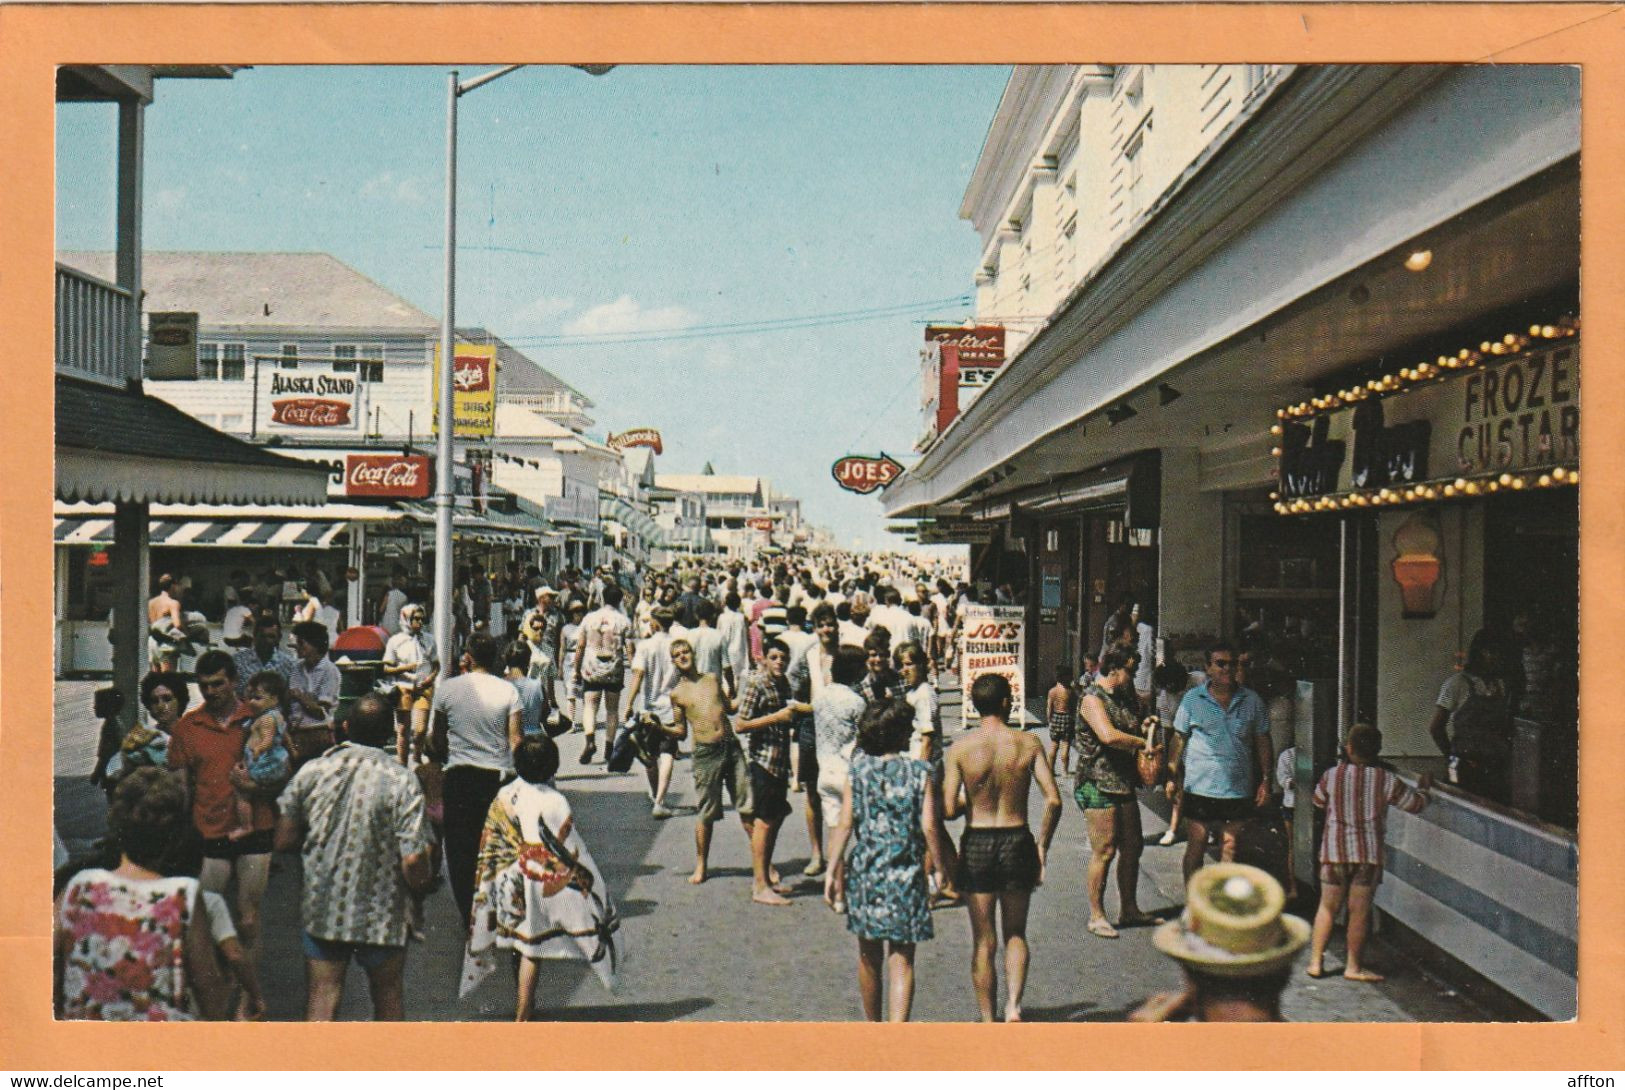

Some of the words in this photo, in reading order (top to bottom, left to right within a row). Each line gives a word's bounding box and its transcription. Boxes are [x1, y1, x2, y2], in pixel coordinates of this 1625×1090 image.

[271, 372, 314, 395] ALASKA
[317, 374, 354, 396] STAND
[350, 460, 420, 487] Coca-Cola
[840, 462, 892, 481] JOES
[967, 622, 1021, 639] JOE'S
[965, 641, 1020, 654] RESTAURANT
[968, 655, 1019, 669] BREAKFAST
